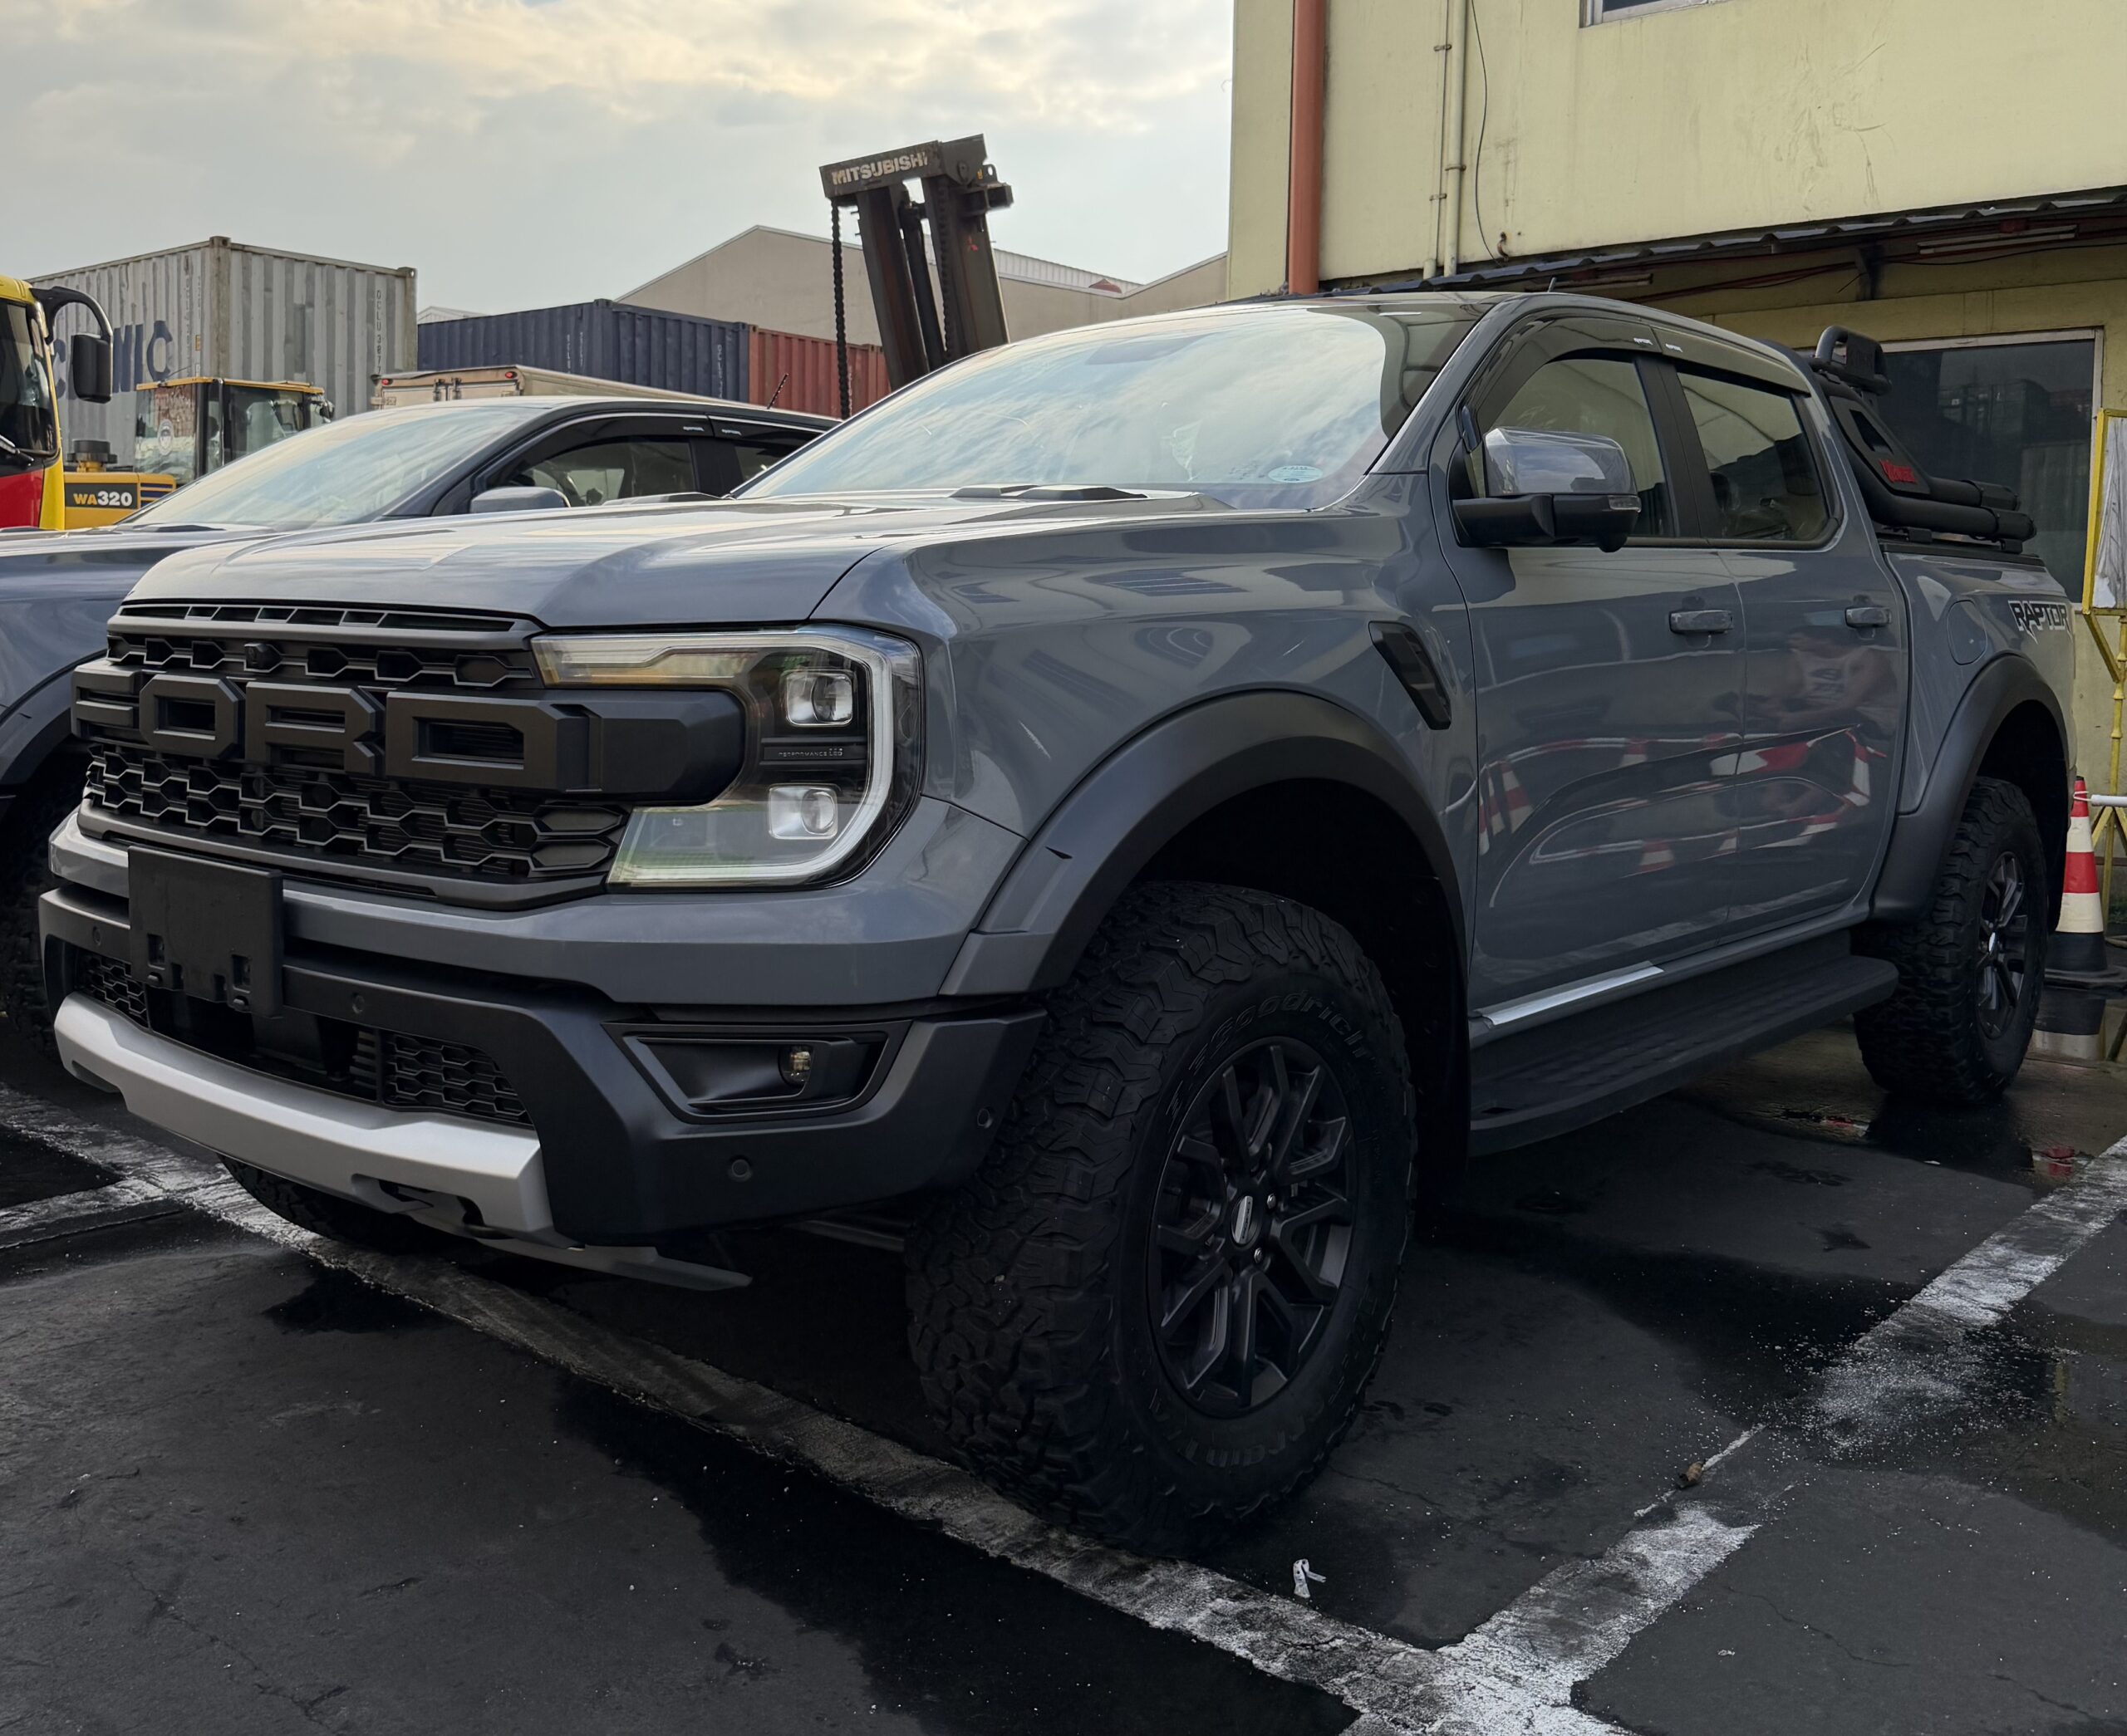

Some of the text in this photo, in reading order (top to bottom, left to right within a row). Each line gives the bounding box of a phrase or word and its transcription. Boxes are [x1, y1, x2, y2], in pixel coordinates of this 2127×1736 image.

[832, 151, 929, 186] MITSUBISHI
[73, 490, 133, 507] WA320
[2008, 600, 2073, 645] RAPTOR
[71, 664, 586, 791] FORD
